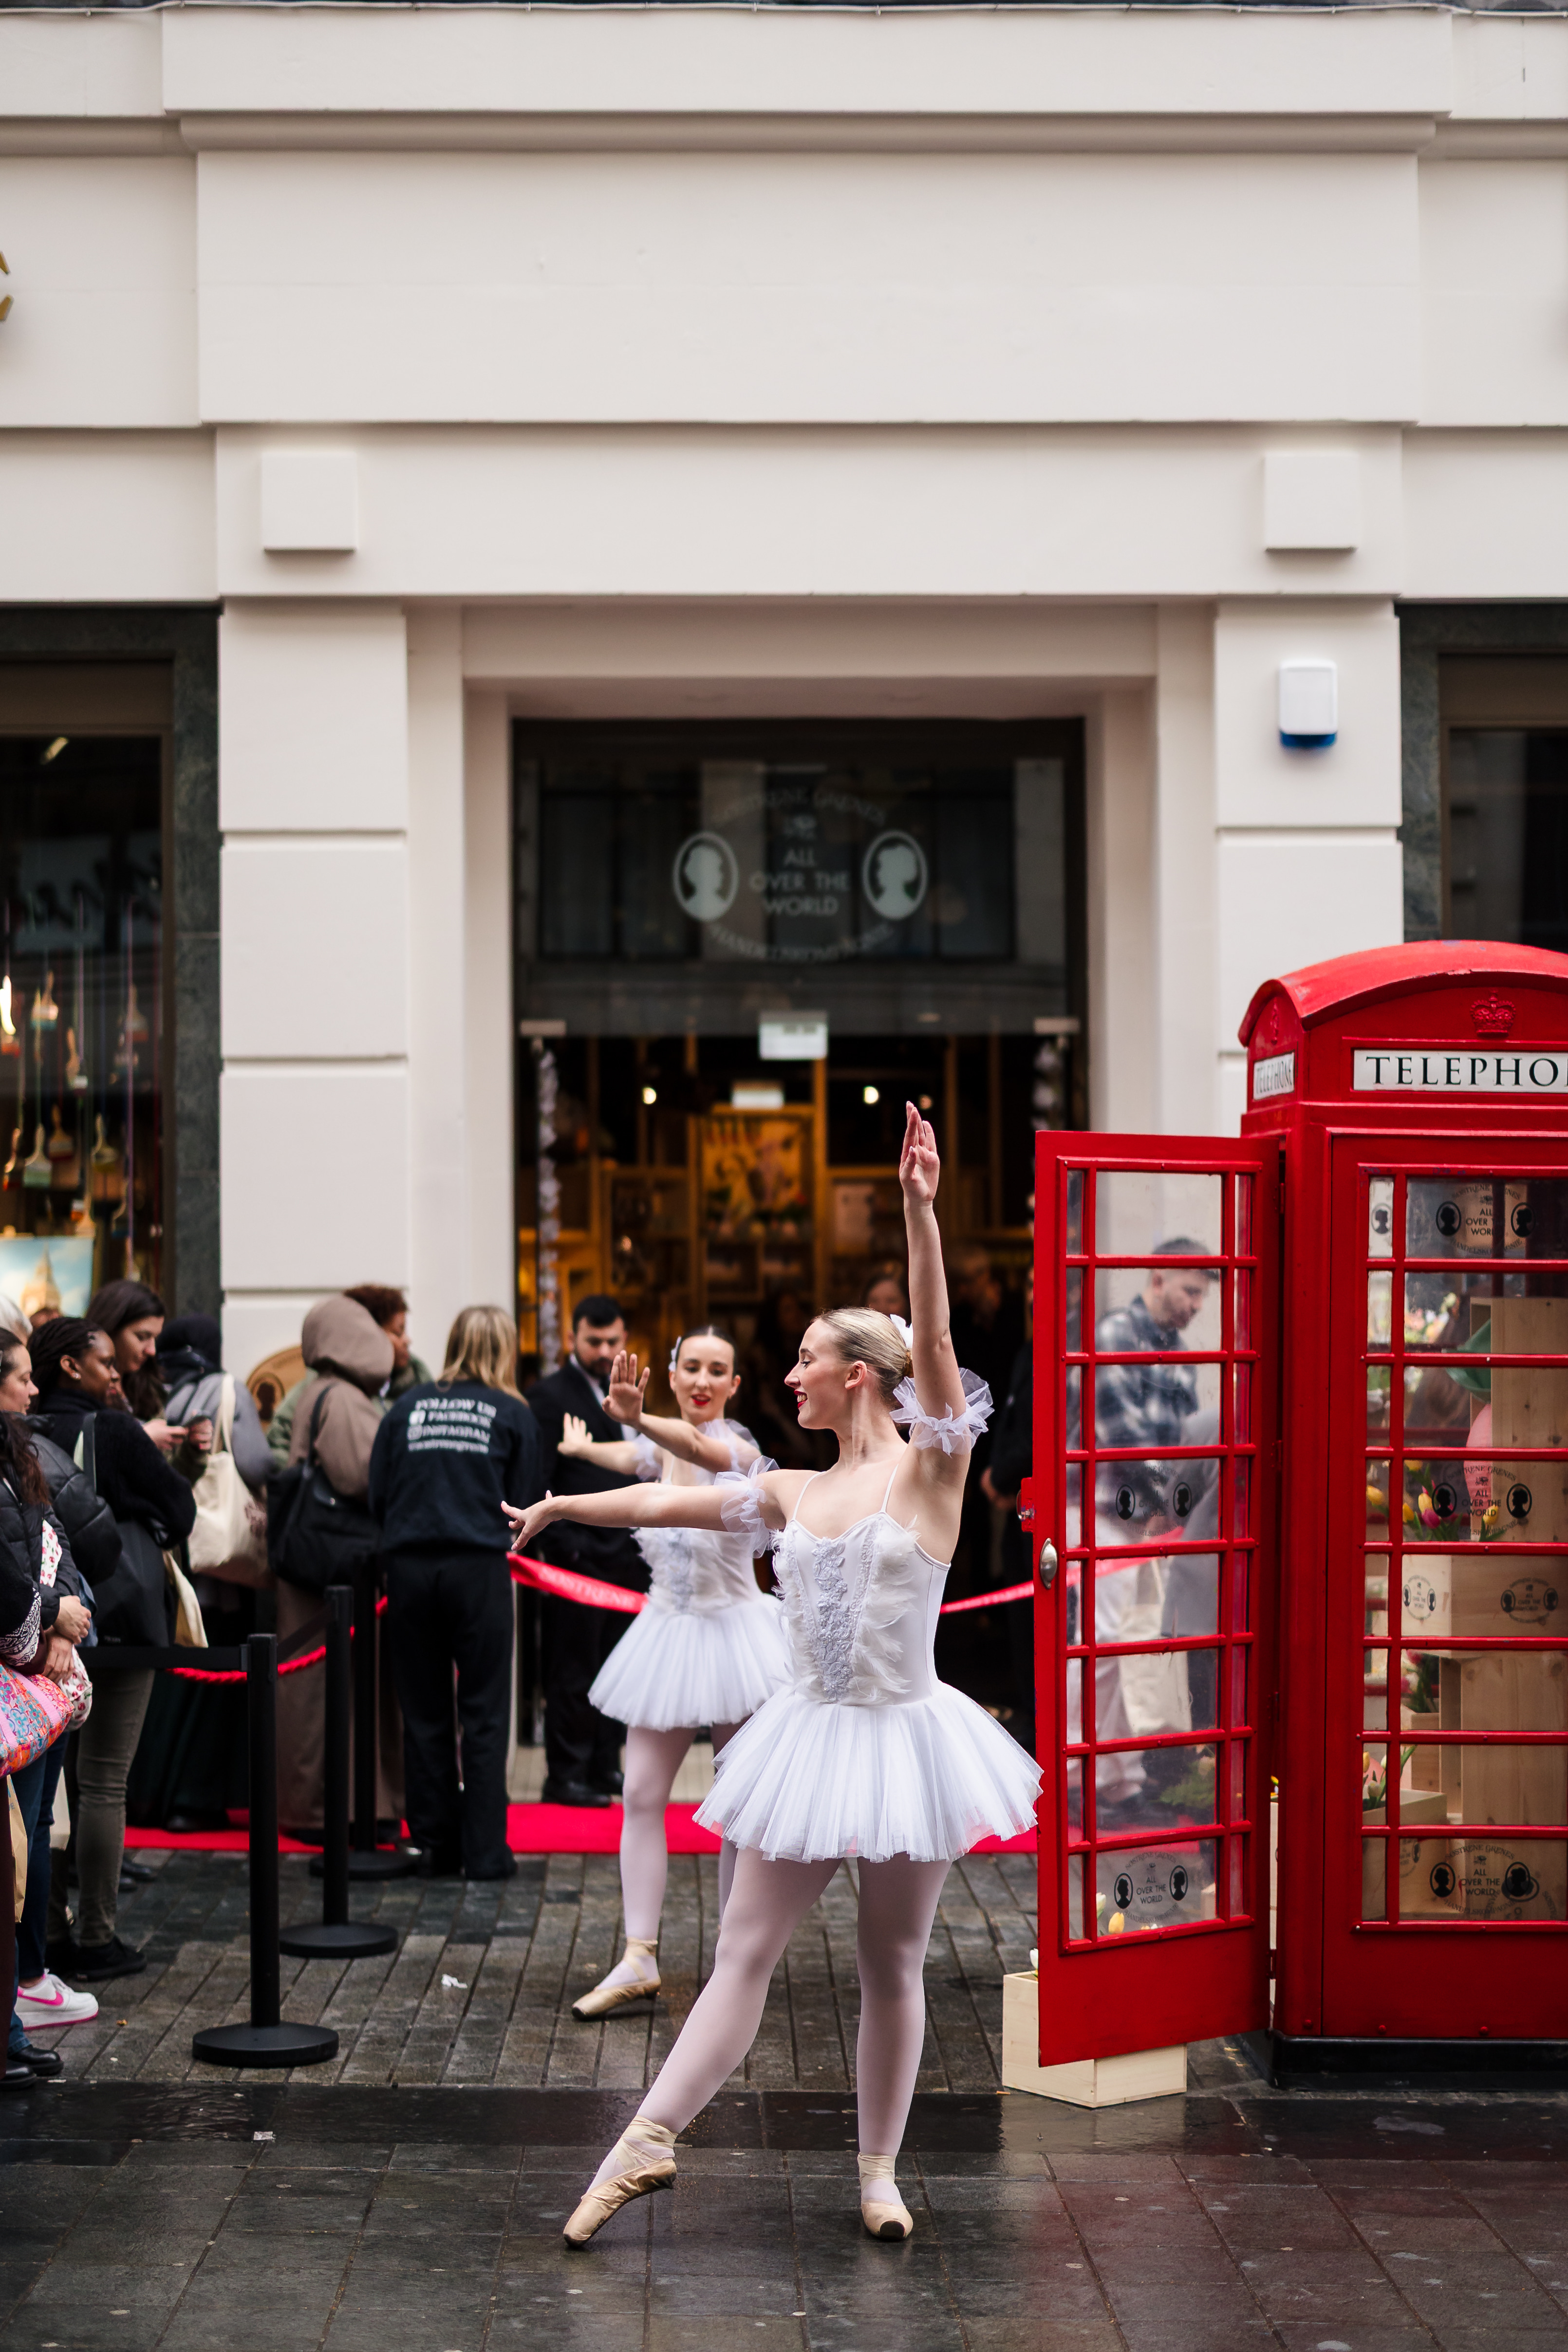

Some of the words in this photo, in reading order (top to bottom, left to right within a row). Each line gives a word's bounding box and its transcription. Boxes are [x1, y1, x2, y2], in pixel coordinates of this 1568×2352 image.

[783, 848, 817, 868] ALL
[748, 871, 806, 893] OVER
[815, 871, 851, 892] THE
[763, 896, 838, 916] WORLD
[1365, 1056, 1568, 1087] TELEPHO
[1465, 1218, 1488, 1226] OVER
[1471, 1228, 1493, 1236] WOR
[1136, 1886, 1153, 1895] OVER
[1155, 1884, 1167, 1892] THE
[1140, 1895, 1163, 1904] WORLD
